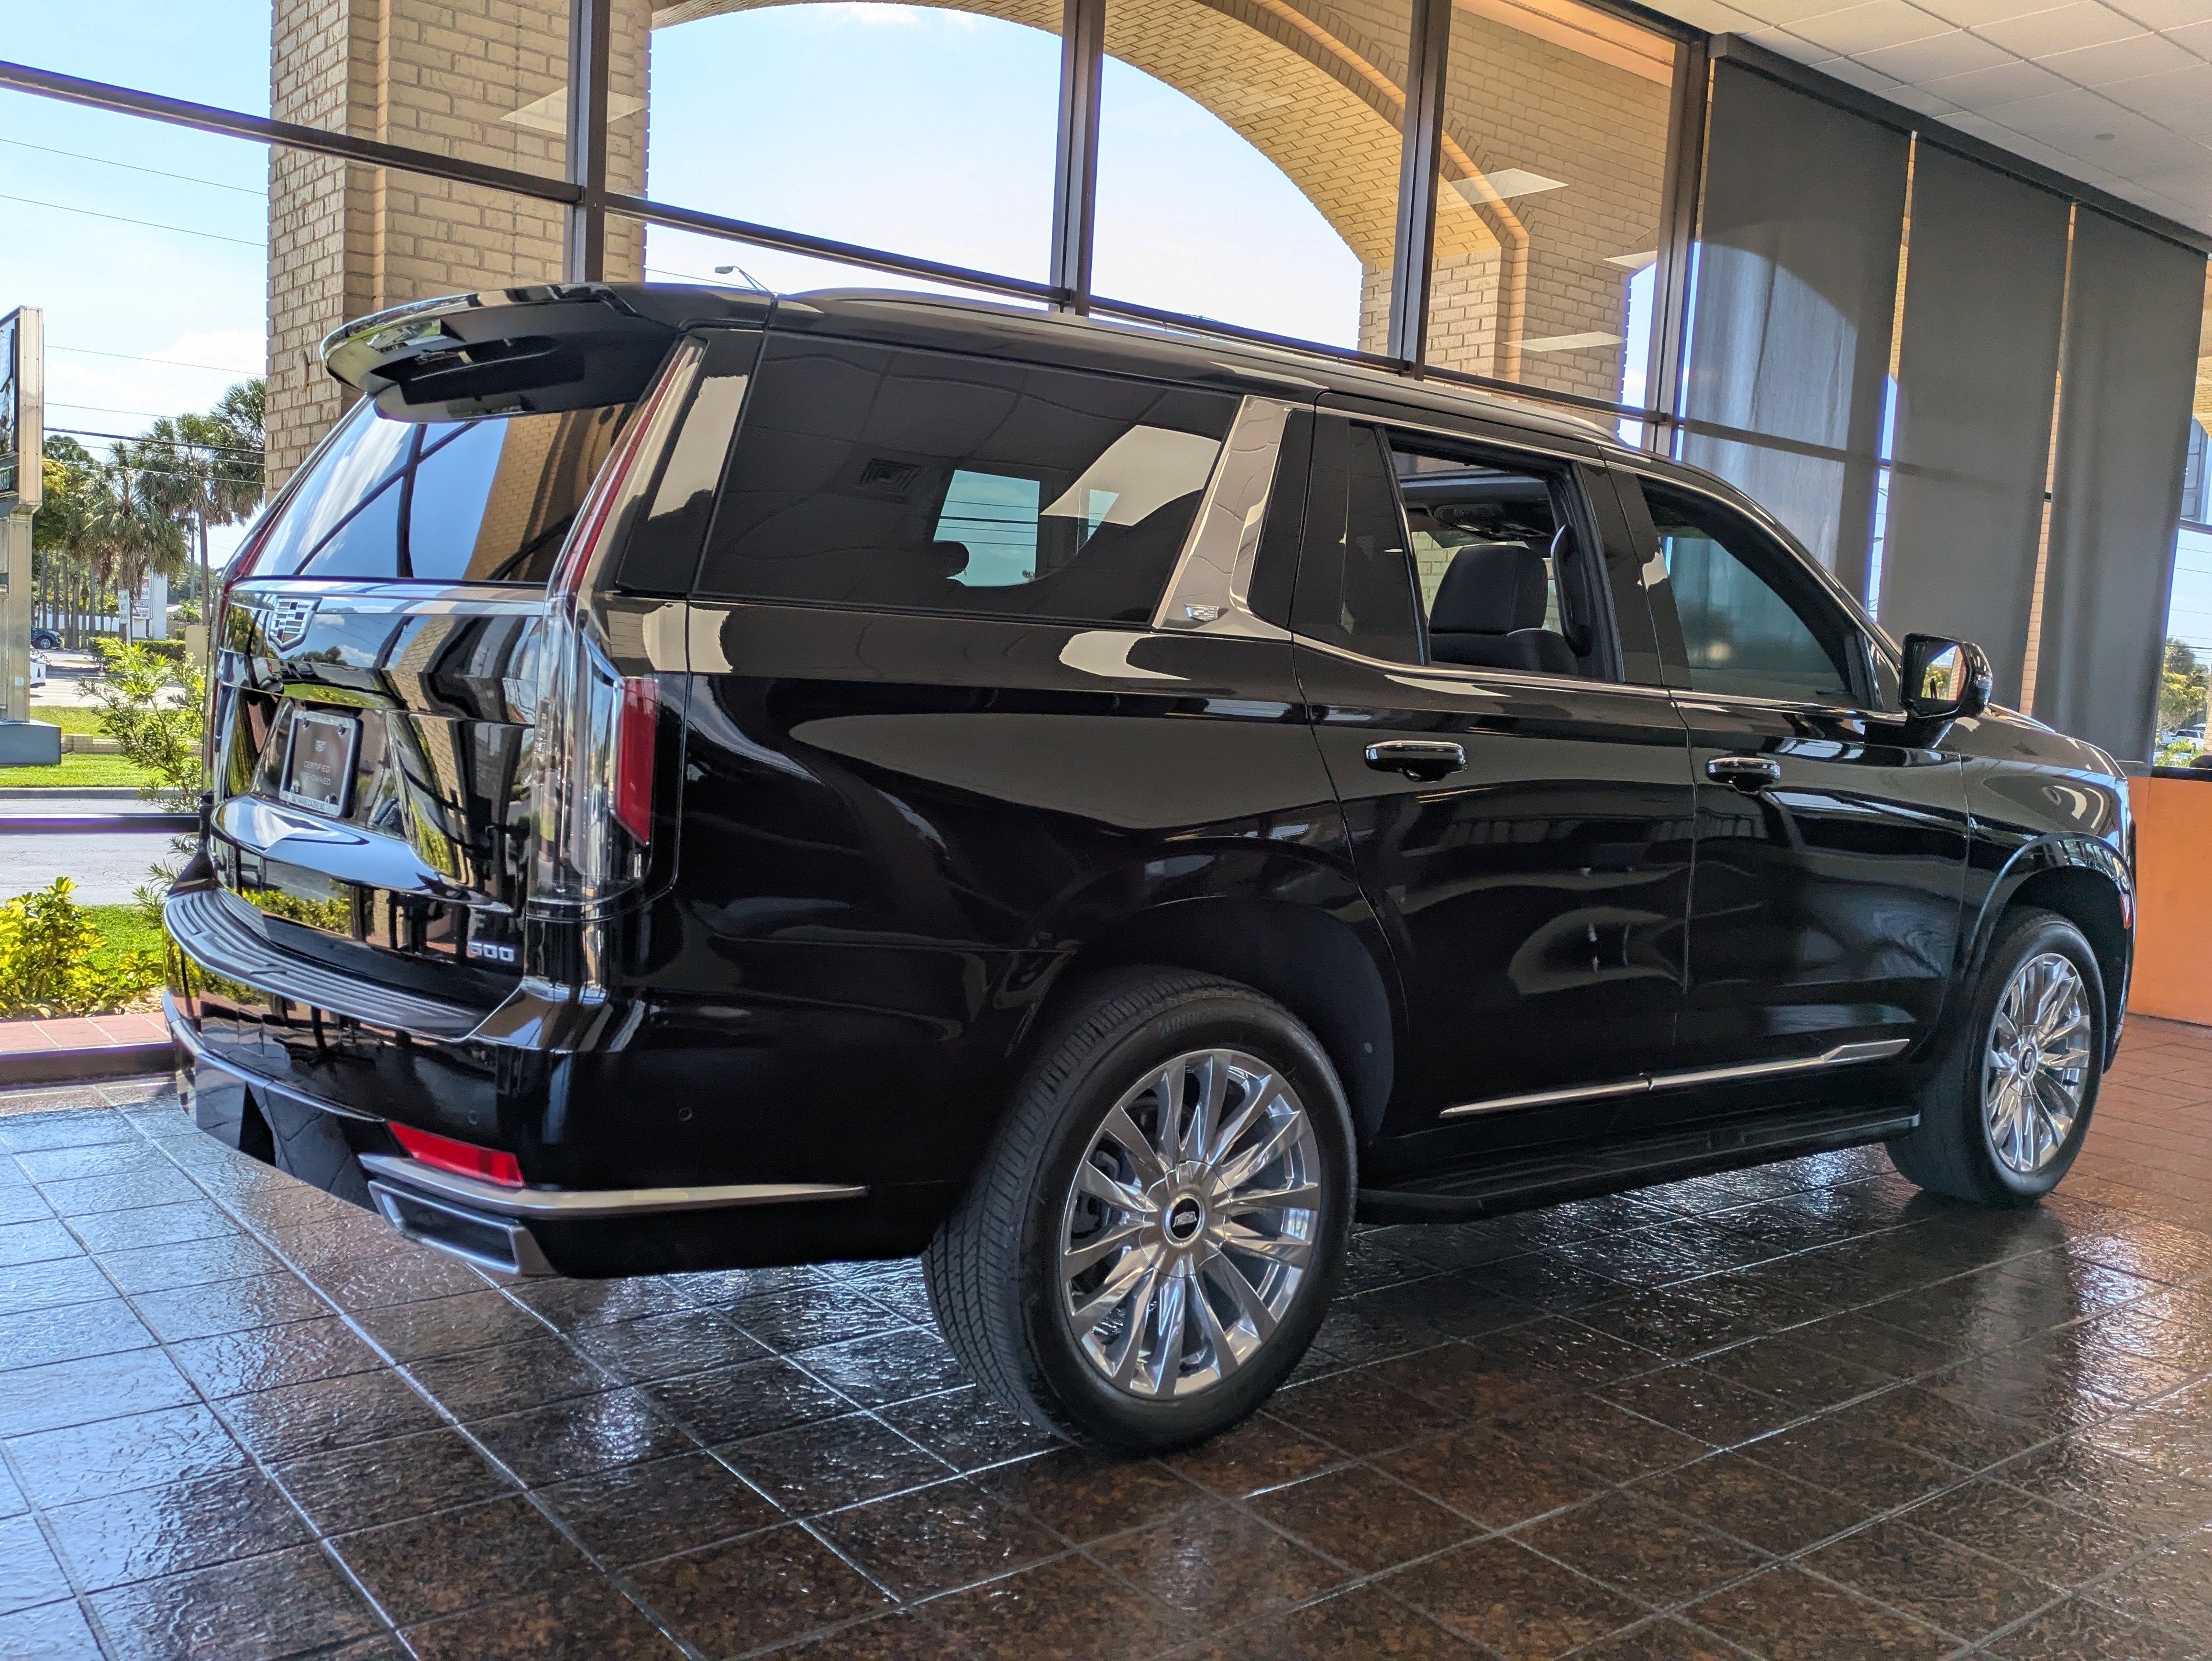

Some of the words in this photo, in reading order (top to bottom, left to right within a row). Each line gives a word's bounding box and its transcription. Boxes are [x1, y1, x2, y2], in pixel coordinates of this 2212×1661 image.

[304, 761, 330, 773] CERTIFIED
[300, 772, 331, 785] PRE-OWNED
[466, 941, 514, 962] 600
